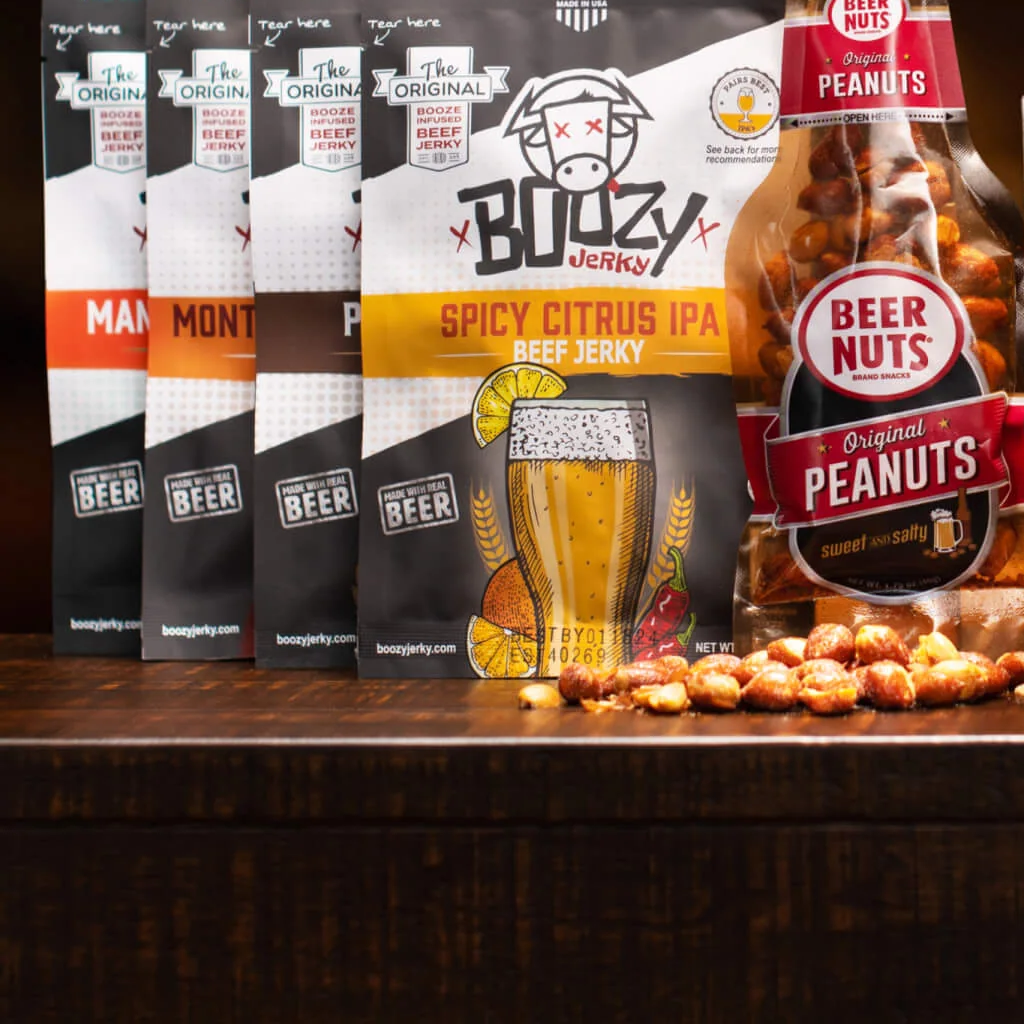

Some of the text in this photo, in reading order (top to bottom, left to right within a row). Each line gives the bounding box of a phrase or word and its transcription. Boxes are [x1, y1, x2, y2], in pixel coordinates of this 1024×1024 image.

[50, 22, 121, 34] Tear here
[153, 18, 226, 31] Tear here
[258, 16, 331, 30] Tear here
[368, 16, 441, 29] Tear here
[844, 11, 890, 32] NUTS
[843, 52, 895, 67] Original
[102, 64, 137, 86] The
[205, 61, 242, 84] The
[313, 59, 351, 82] The
[420, 58, 459, 82] The
[395, 82, 486, 98] ORIGINAL
[723, 76, 770, 94] PAIRS BEST
[818, 70, 926, 99] PEANUTS
[181, 85, 249, 99] ORIGIN
[202, 109, 245, 117] BOOZE
[310, 107, 355, 116] BOOZE
[417, 106, 462, 115] BOOZE
[310, 117, 355, 125] INFUSED
[417, 116, 462, 124] INFUSED
[843, 113, 869, 123] OPEN
[101, 130, 143, 141] BEEF
[202, 129, 246, 139] BEEF
[310, 128, 356, 139] BEEF
[417, 127, 462, 139] BEEF
[101, 143, 144, 152] JERKY
[201, 142, 246, 151] JERKY
[310, 140, 356, 151] JERKY
[416, 139, 462, 150] JERKY
[706, 145, 722, 154] See
[724, 145, 744, 154] back
[747, 146, 760, 154] for
[440, 301, 720, 338] SPICY CITRUS IPA
[831, 296, 926, 331] BEER
[513, 339, 645, 365] BEEF JERKY
[832, 333, 929, 376] NUTS
[880, 372, 911, 380] SNACKS
[843, 419, 926, 454] Original
[805, 435, 978, 512] PEANUTS
[78, 478, 140, 511] BEER
[282, 483, 305, 496] MADE
[384, 489, 405, 502] MADE
[172, 481, 236, 516] BEER
[284, 486, 352, 522] BEER
[385, 492, 452, 529] BEER
[820, 534, 867, 558] sweet
[892, 523, 928, 546] salty
[162, 624, 240, 638] boozyjerky.com
[277, 632, 356, 646] boozyjerky.com
[376, 643, 457, 656] boozyjerky.com
[695, 641, 717, 653] NET
